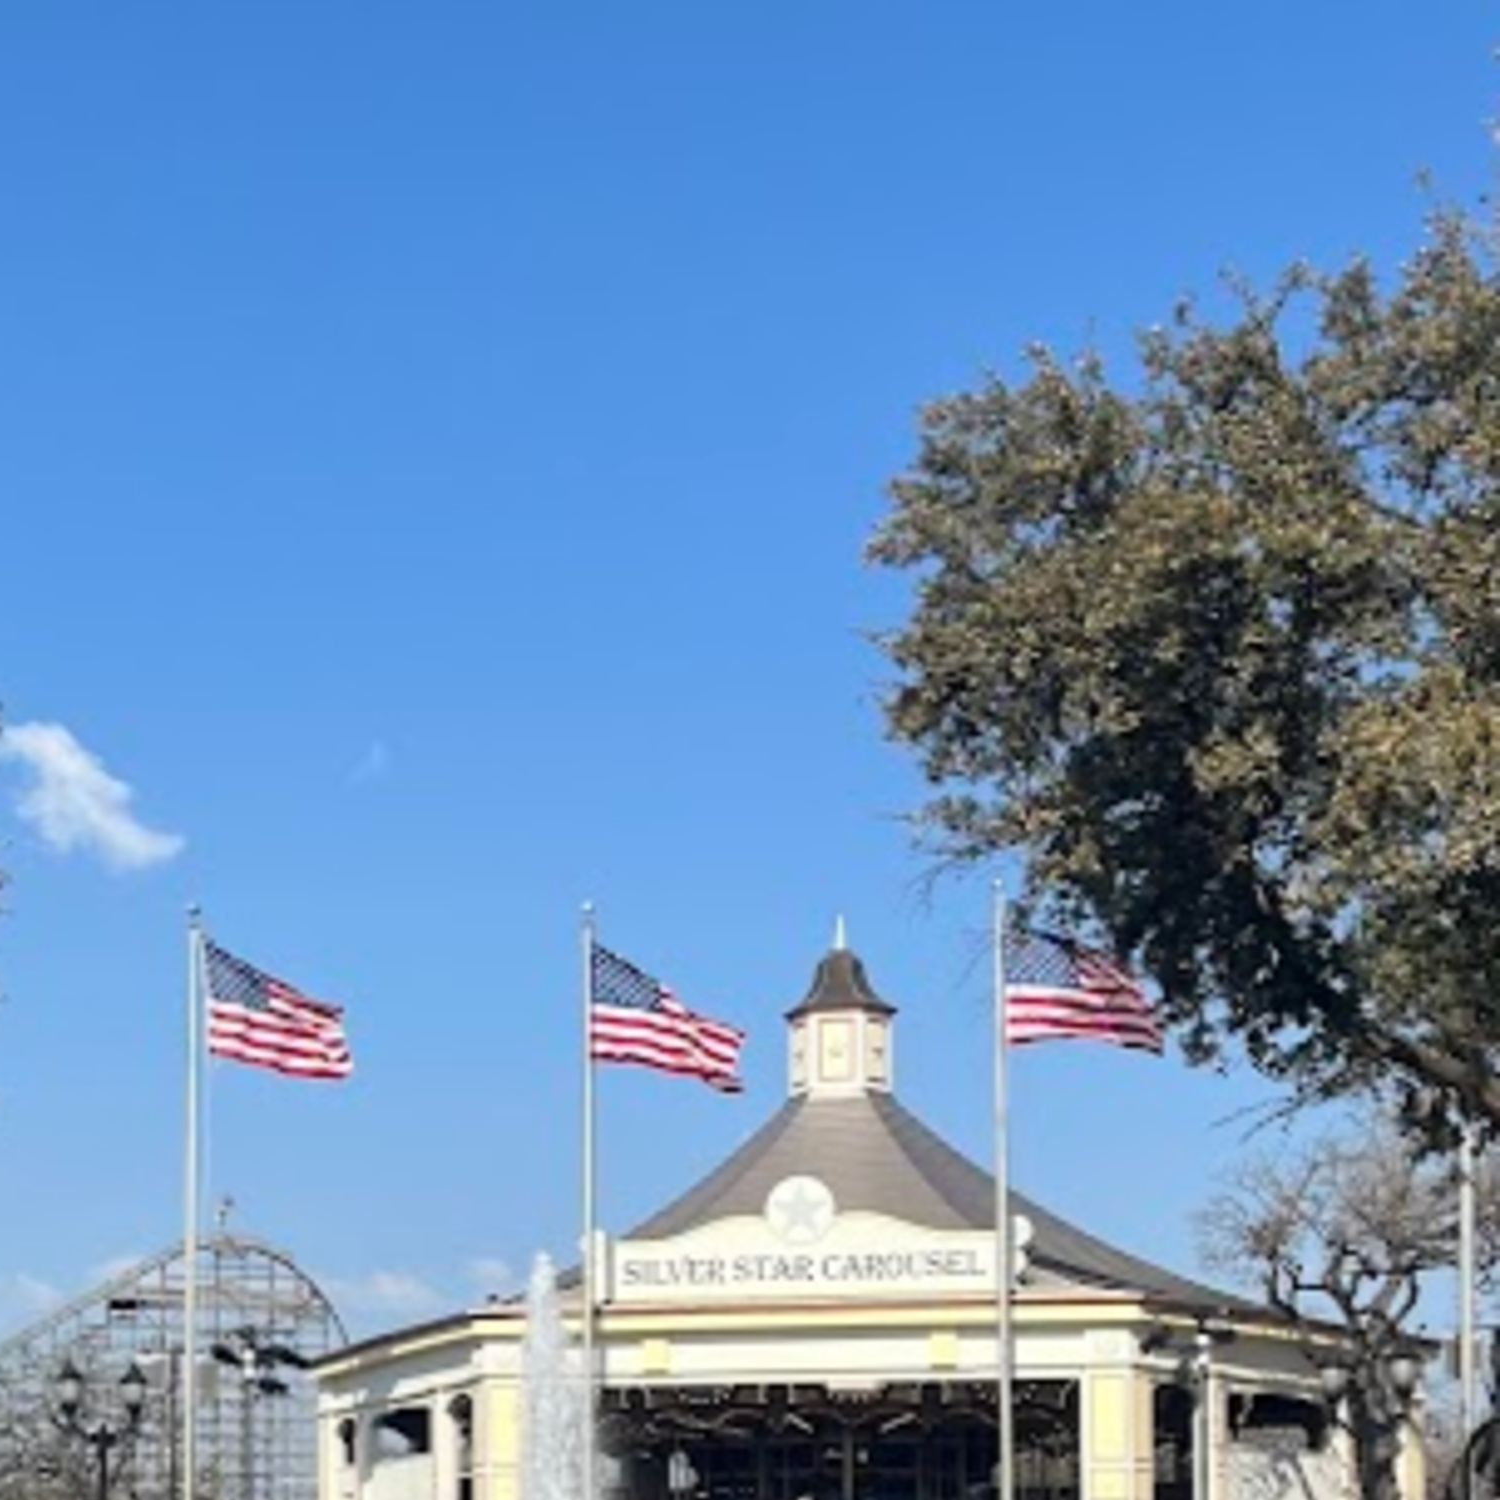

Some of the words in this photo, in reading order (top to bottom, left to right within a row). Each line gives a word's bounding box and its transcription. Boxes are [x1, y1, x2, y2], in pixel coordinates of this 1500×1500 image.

[621, 1256, 726, 1286] SILVER
[732, 1254, 815, 1282] STAR
[821, 1249, 987, 1281] CAROUSEL
